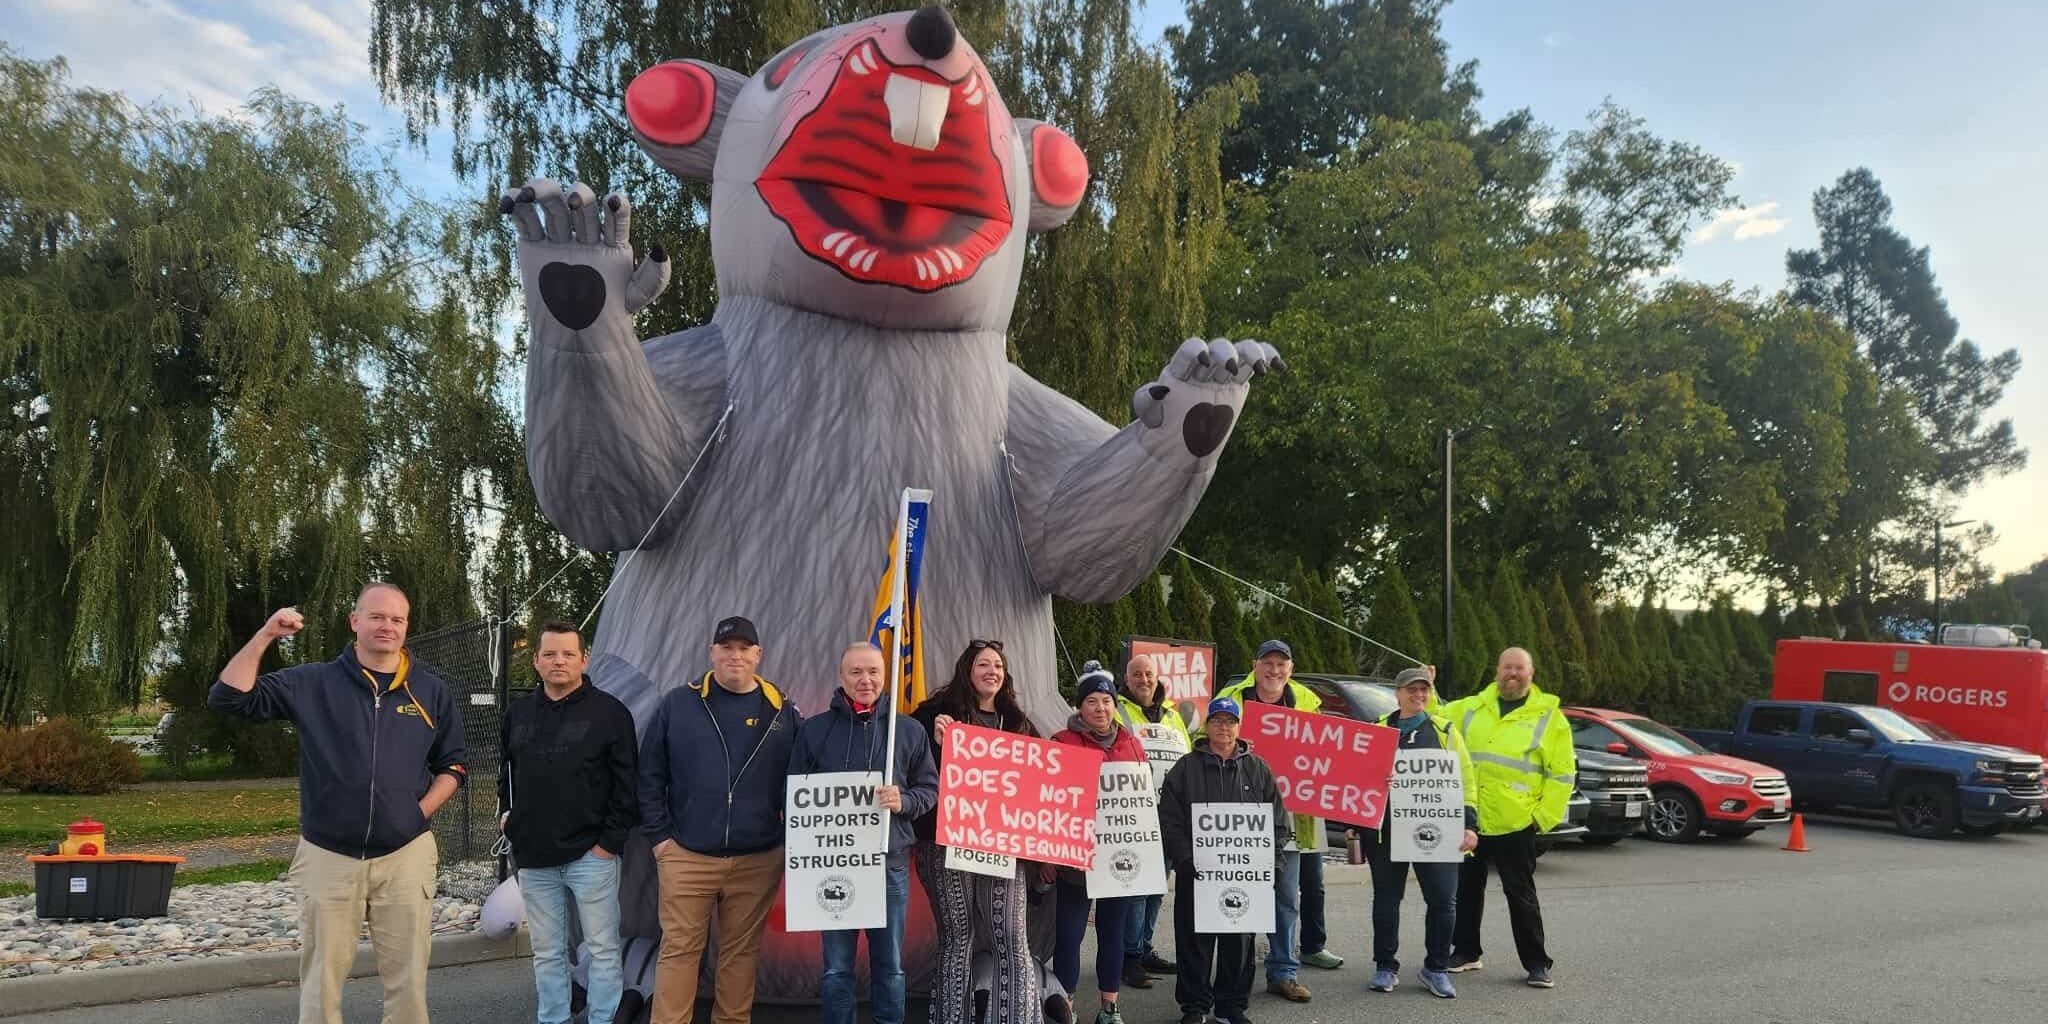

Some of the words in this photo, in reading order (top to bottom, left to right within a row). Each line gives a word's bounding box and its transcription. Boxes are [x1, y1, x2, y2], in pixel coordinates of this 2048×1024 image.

[1150, 652, 1187, 675] IVE
[1190, 651, 1207, 673] A
[1157, 674, 1209, 699] ONK
[1916, 687, 2008, 708] ROGERS
[1260, 713, 1374, 754] SHAME
[951, 728, 1062, 775] ROGERS
[1294, 755, 1331, 776] ON
[1394, 759, 1454, 774] CUPW
[945, 763, 1020, 797] DOES
[1040, 784, 1085, 809] NOT
[1100, 773, 1147, 792] UPW
[1392, 779, 1460, 789] SUPPORTS
[793, 785, 875, 808] CUPW
[1096, 797, 1154, 810] PPORTS
[1275, 775, 1382, 818] OGERS
[1412, 793, 1442, 803] THIS
[790, 812, 880, 828] SUPPORTS
[944, 795, 988, 830] PAY
[1105, 814, 1137, 826] THIS
[1393, 808, 1462, 818] STRUGGLE
[1198, 814, 1266, 832] CUPW
[815, 834, 855, 847] THIS
[945, 825, 1022, 854] WAGES
[1025, 836, 1096, 866] EQUALLY
[1095, 831, 1160, 845] TRUGGLE
[1196, 836, 1271, 848] SUPPORTS
[789, 853, 881, 869] STRUGGLE
[954, 847, 1009, 867] ROGERS
[1217, 853, 1250, 865] THIS
[1197, 870, 1271, 882] STRUGGLE
